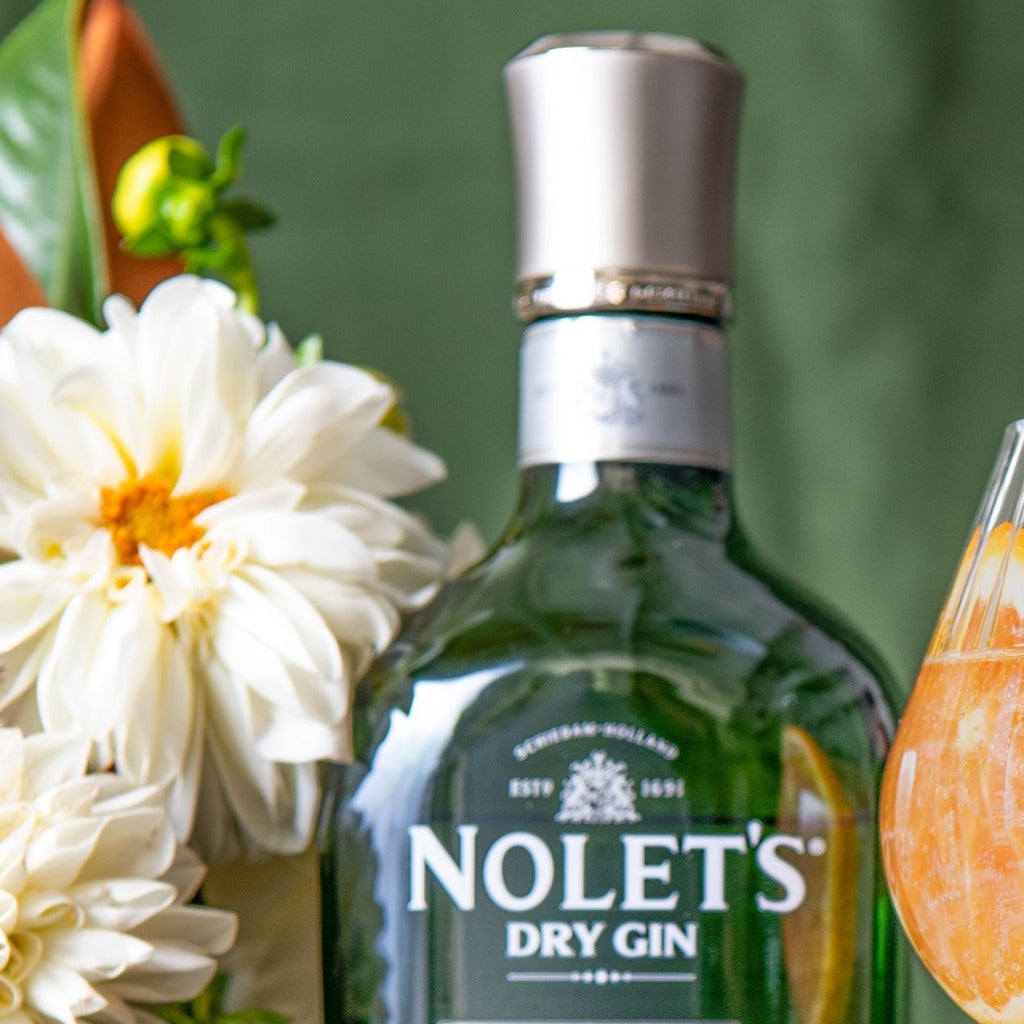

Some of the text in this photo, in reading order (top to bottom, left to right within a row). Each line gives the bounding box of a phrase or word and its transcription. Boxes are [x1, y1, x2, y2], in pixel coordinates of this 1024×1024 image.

[408, 819, 808, 913] NOLET'S
[505, 921, 698, 958] DRY GIN
